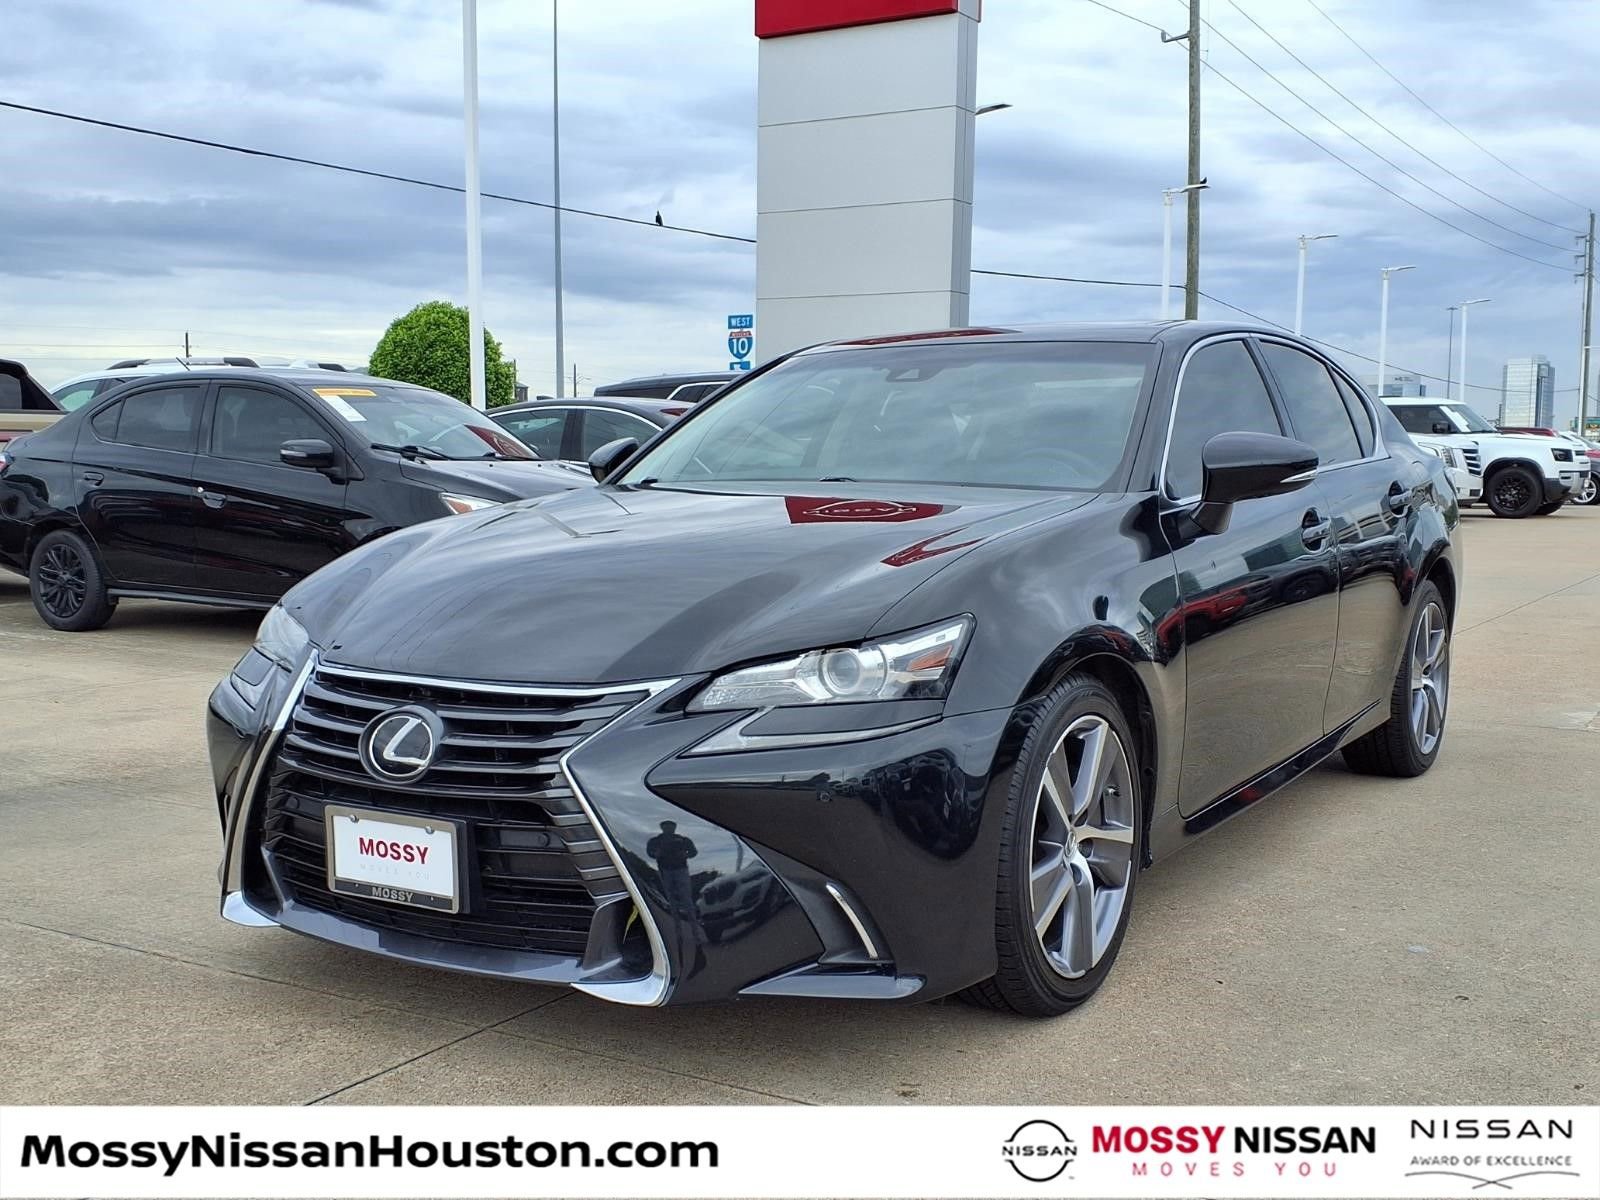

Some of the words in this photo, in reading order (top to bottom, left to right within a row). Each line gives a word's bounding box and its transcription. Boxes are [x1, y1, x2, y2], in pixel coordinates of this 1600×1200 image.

[731, 317, 750, 327] WEST
[733, 338, 749, 354] 10
[359, 837, 429, 865] MOSSY
[371, 887, 414, 903] MOSSY
